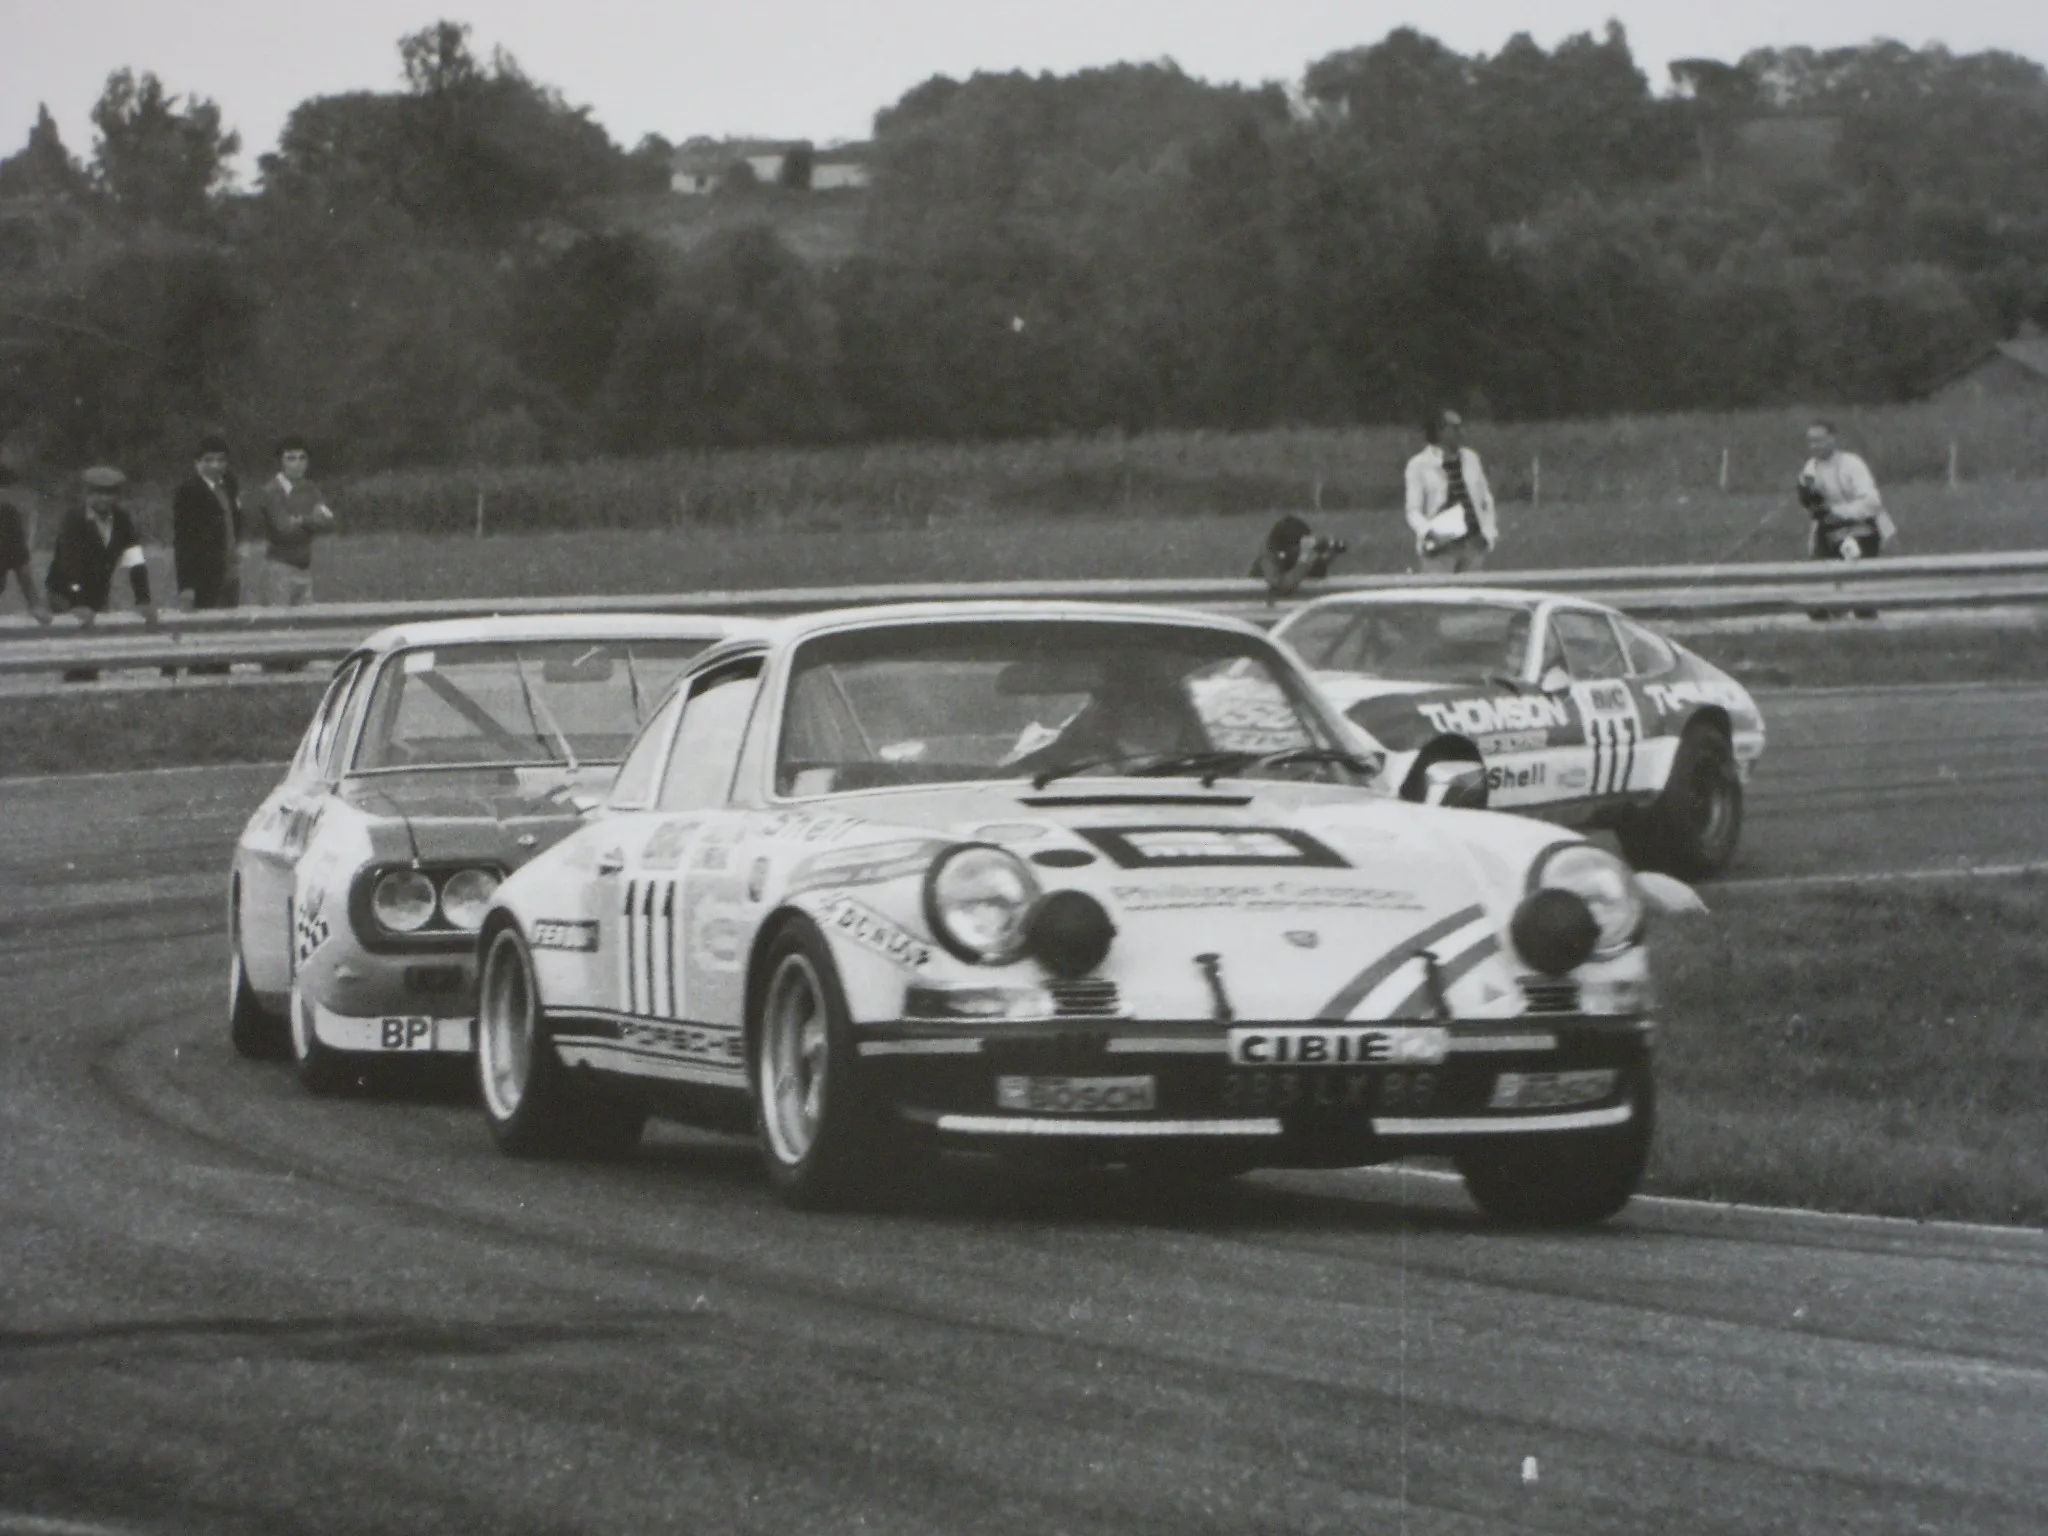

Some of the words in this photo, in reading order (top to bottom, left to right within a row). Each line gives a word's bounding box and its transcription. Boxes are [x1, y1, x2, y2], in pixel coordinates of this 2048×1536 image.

[1417, 695, 1570, 735] THOMSON
[1486, 763, 1546, 791] Shell
[624, 880, 677, 1018] 111
[382, 1019, 429, 1049] BP
